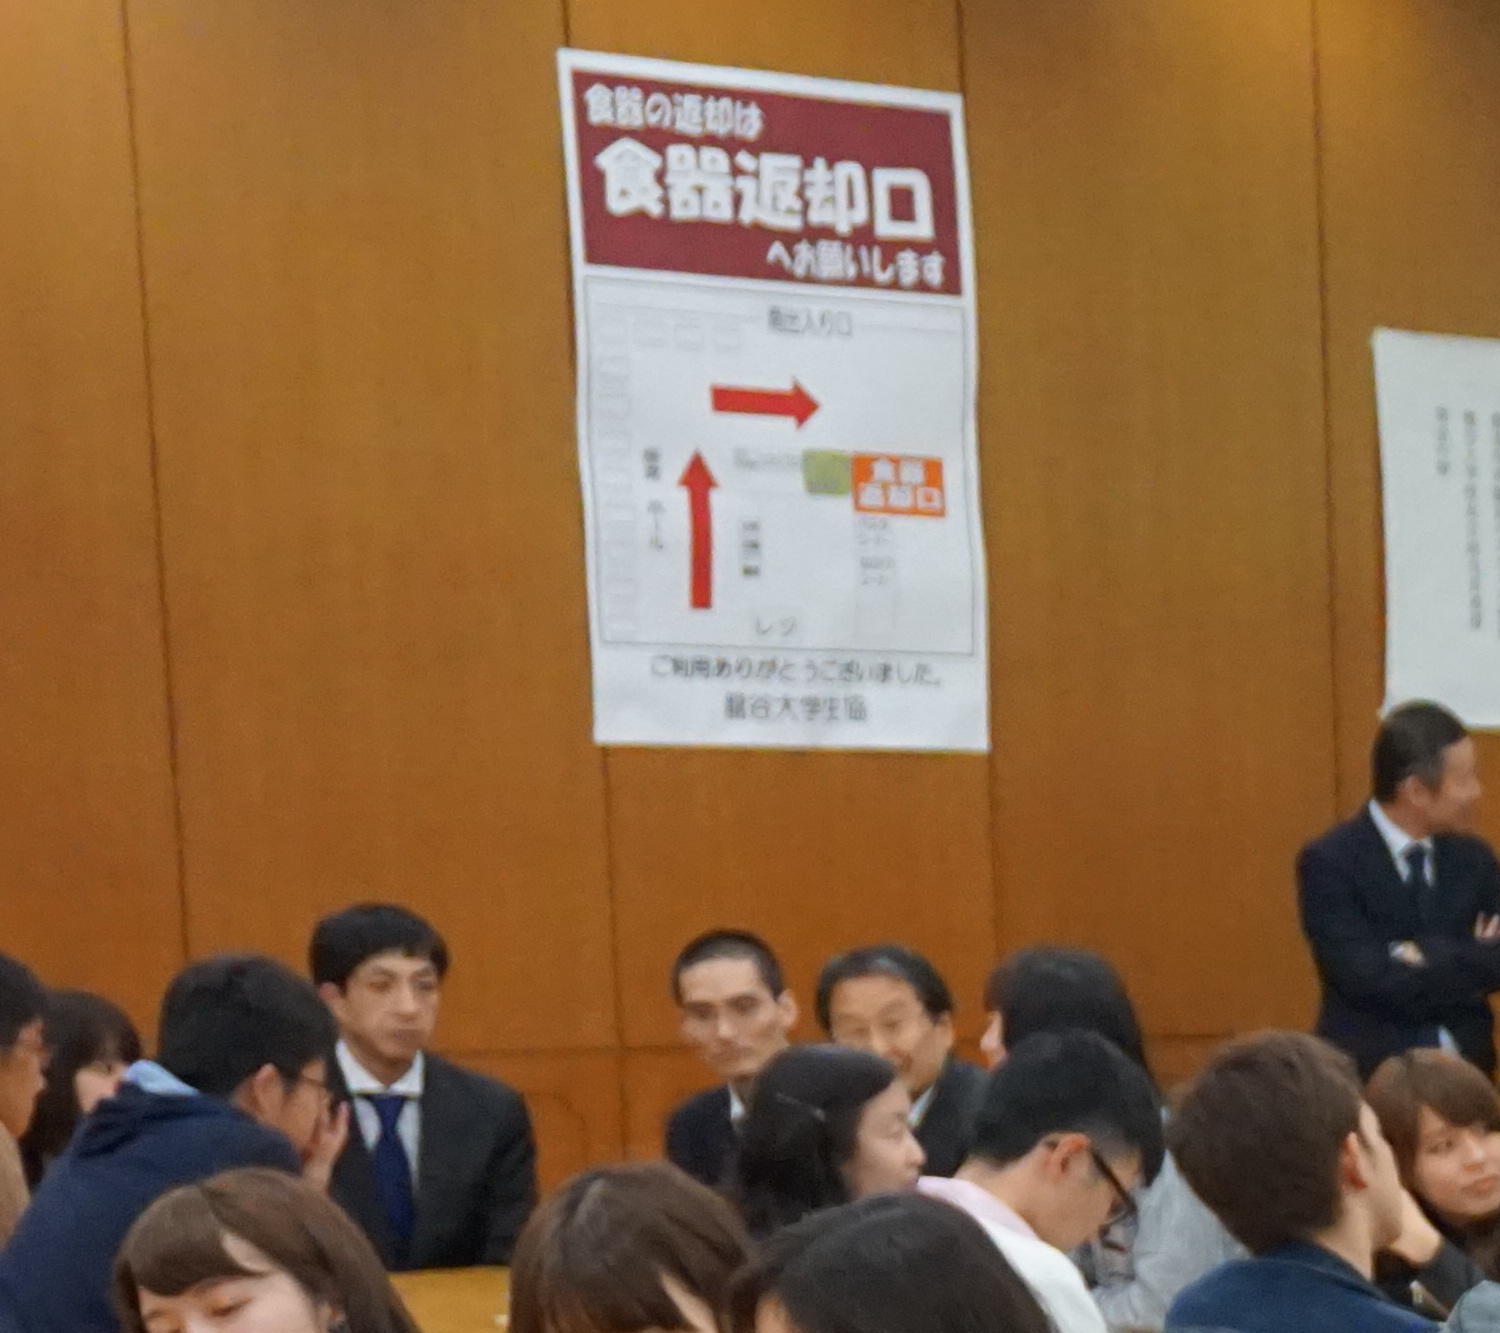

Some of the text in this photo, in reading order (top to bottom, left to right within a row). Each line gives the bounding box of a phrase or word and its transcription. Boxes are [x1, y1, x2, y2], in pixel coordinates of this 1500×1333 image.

[585, 82, 764, 142] 食器の返却は
[594, 136, 935, 241] 食器返却口
[766, 239, 945, 289] へお願いします
